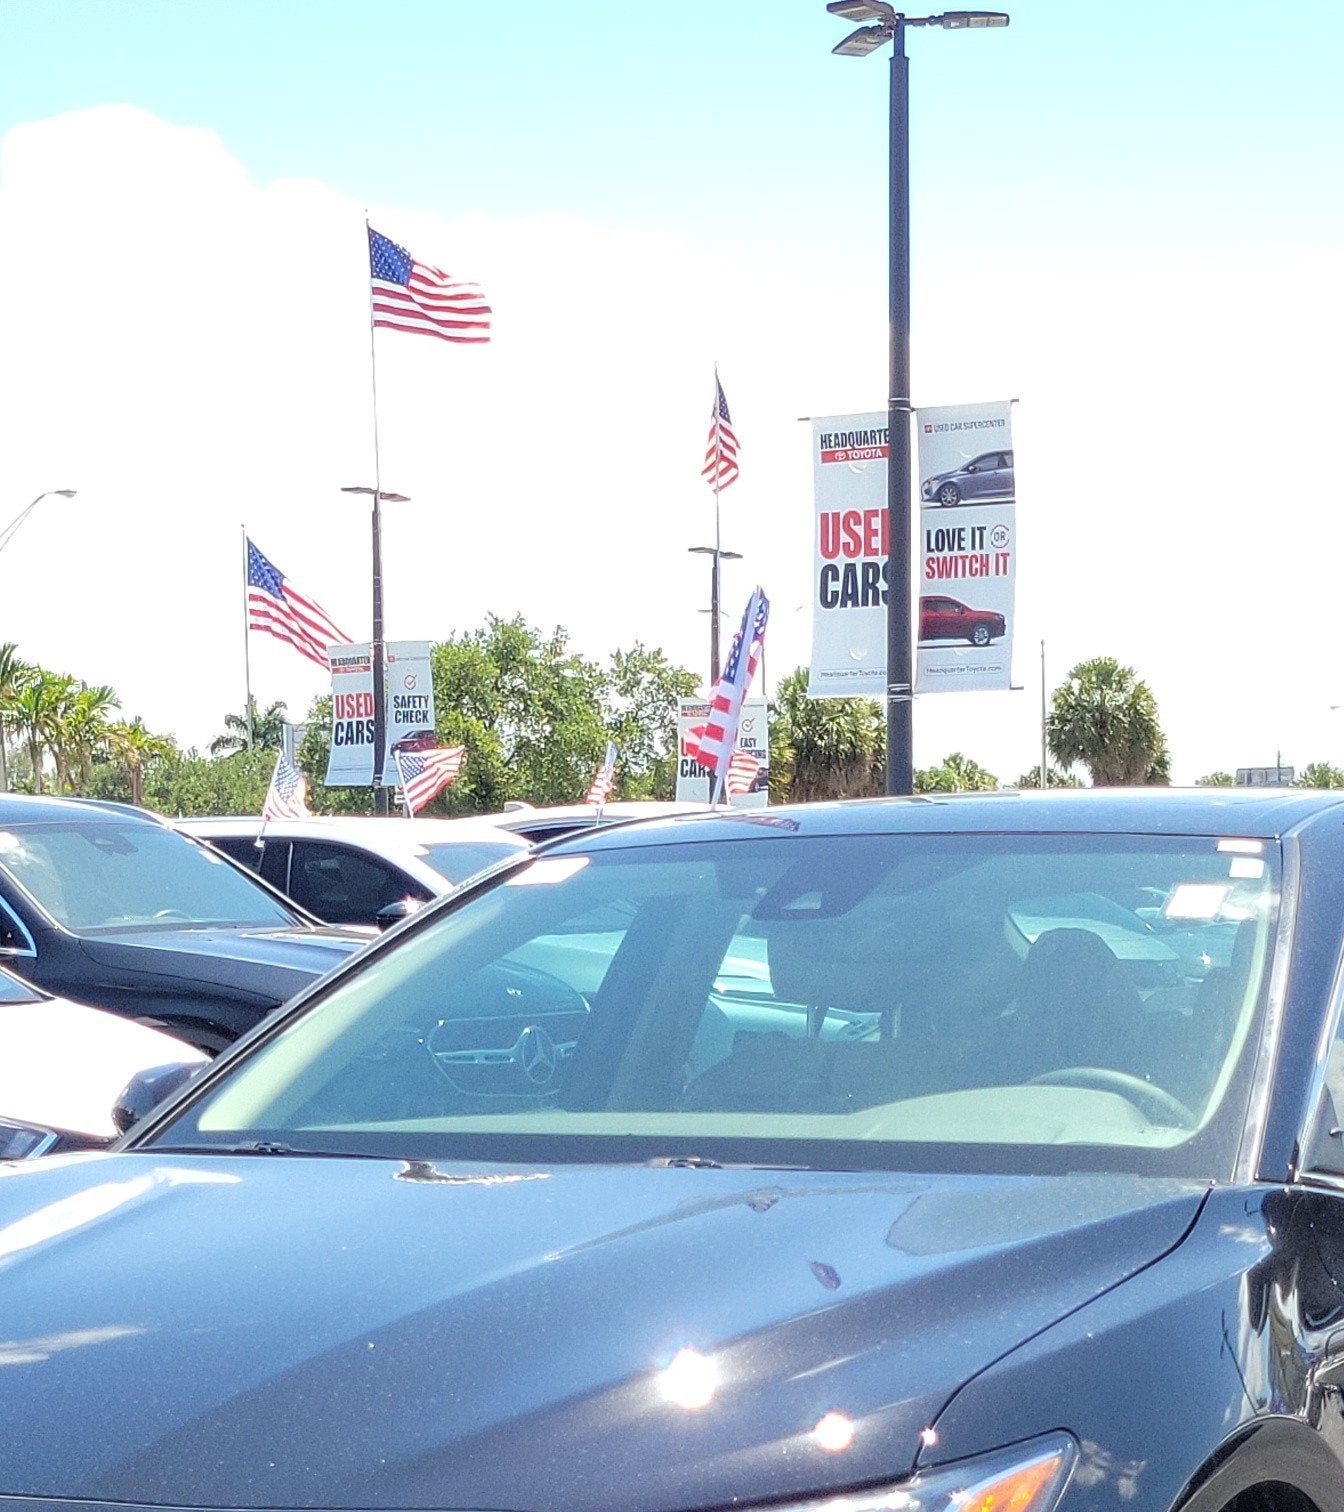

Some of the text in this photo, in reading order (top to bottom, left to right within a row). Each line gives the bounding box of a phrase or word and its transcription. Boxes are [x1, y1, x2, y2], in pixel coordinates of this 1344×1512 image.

[821, 428, 889, 450] HEADQUARTE
[934, 424, 949, 433] USED
[951, 423, 962, 431] CAR
[847, 448, 883, 459] TOYOTA
[926, 526, 1006, 554] LOVE IT OR
[926, 552, 1010, 580] SWITCH IT
[335, 693, 375, 720] USED
[393, 694, 430, 709] SAFETY
[394, 709, 430, 724] CHECK
[334, 719, 376, 747] CARS
